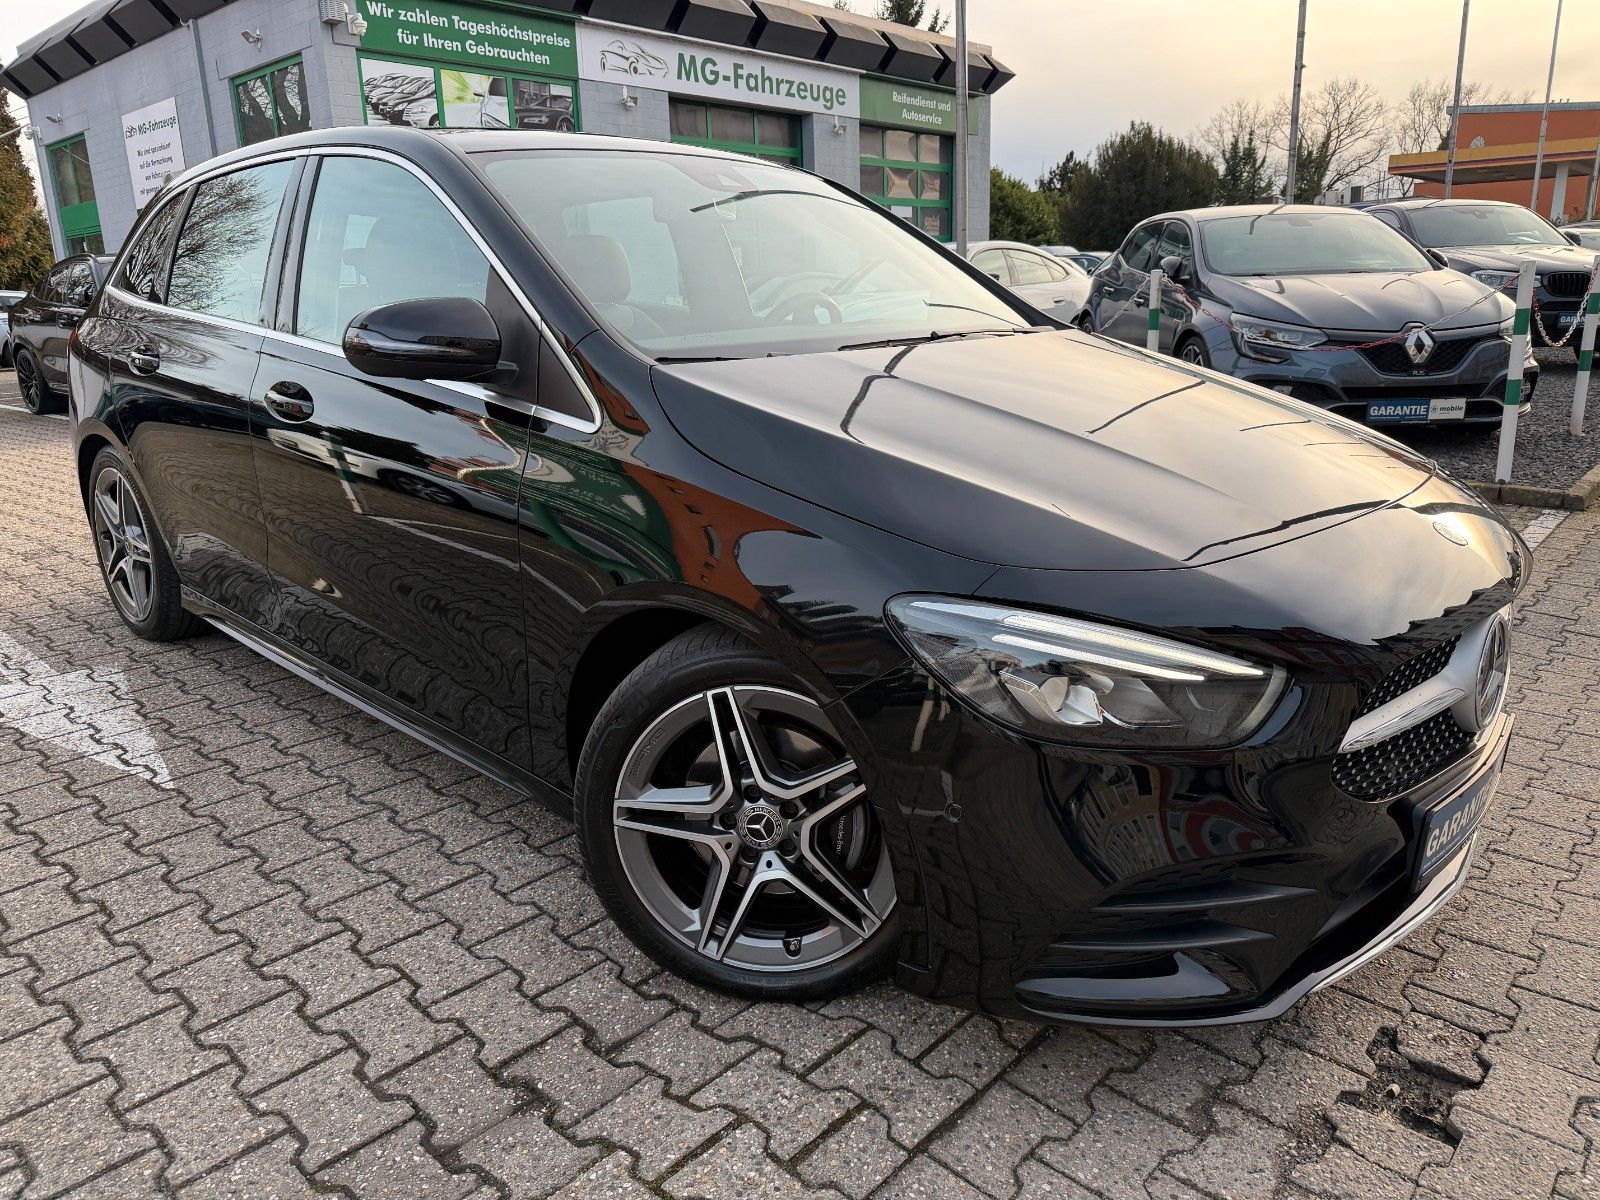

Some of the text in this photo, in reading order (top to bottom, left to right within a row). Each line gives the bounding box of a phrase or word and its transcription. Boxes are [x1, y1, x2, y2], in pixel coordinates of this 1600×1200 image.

[366, 1, 571, 48] Wir zahlen Tageshöchstpreise
[396, 29, 550, 65] für Ihren Gebrauchten
[677, 52, 847, 111] MG-Fahrzeuge
[892, 91, 951, 112] Reifendienst und
[137, 116, 177, 136] MG-Fahrzeuge
[902, 108, 942, 125] Autoservice
[1370, 405, 1428, 416] GARANTIE
